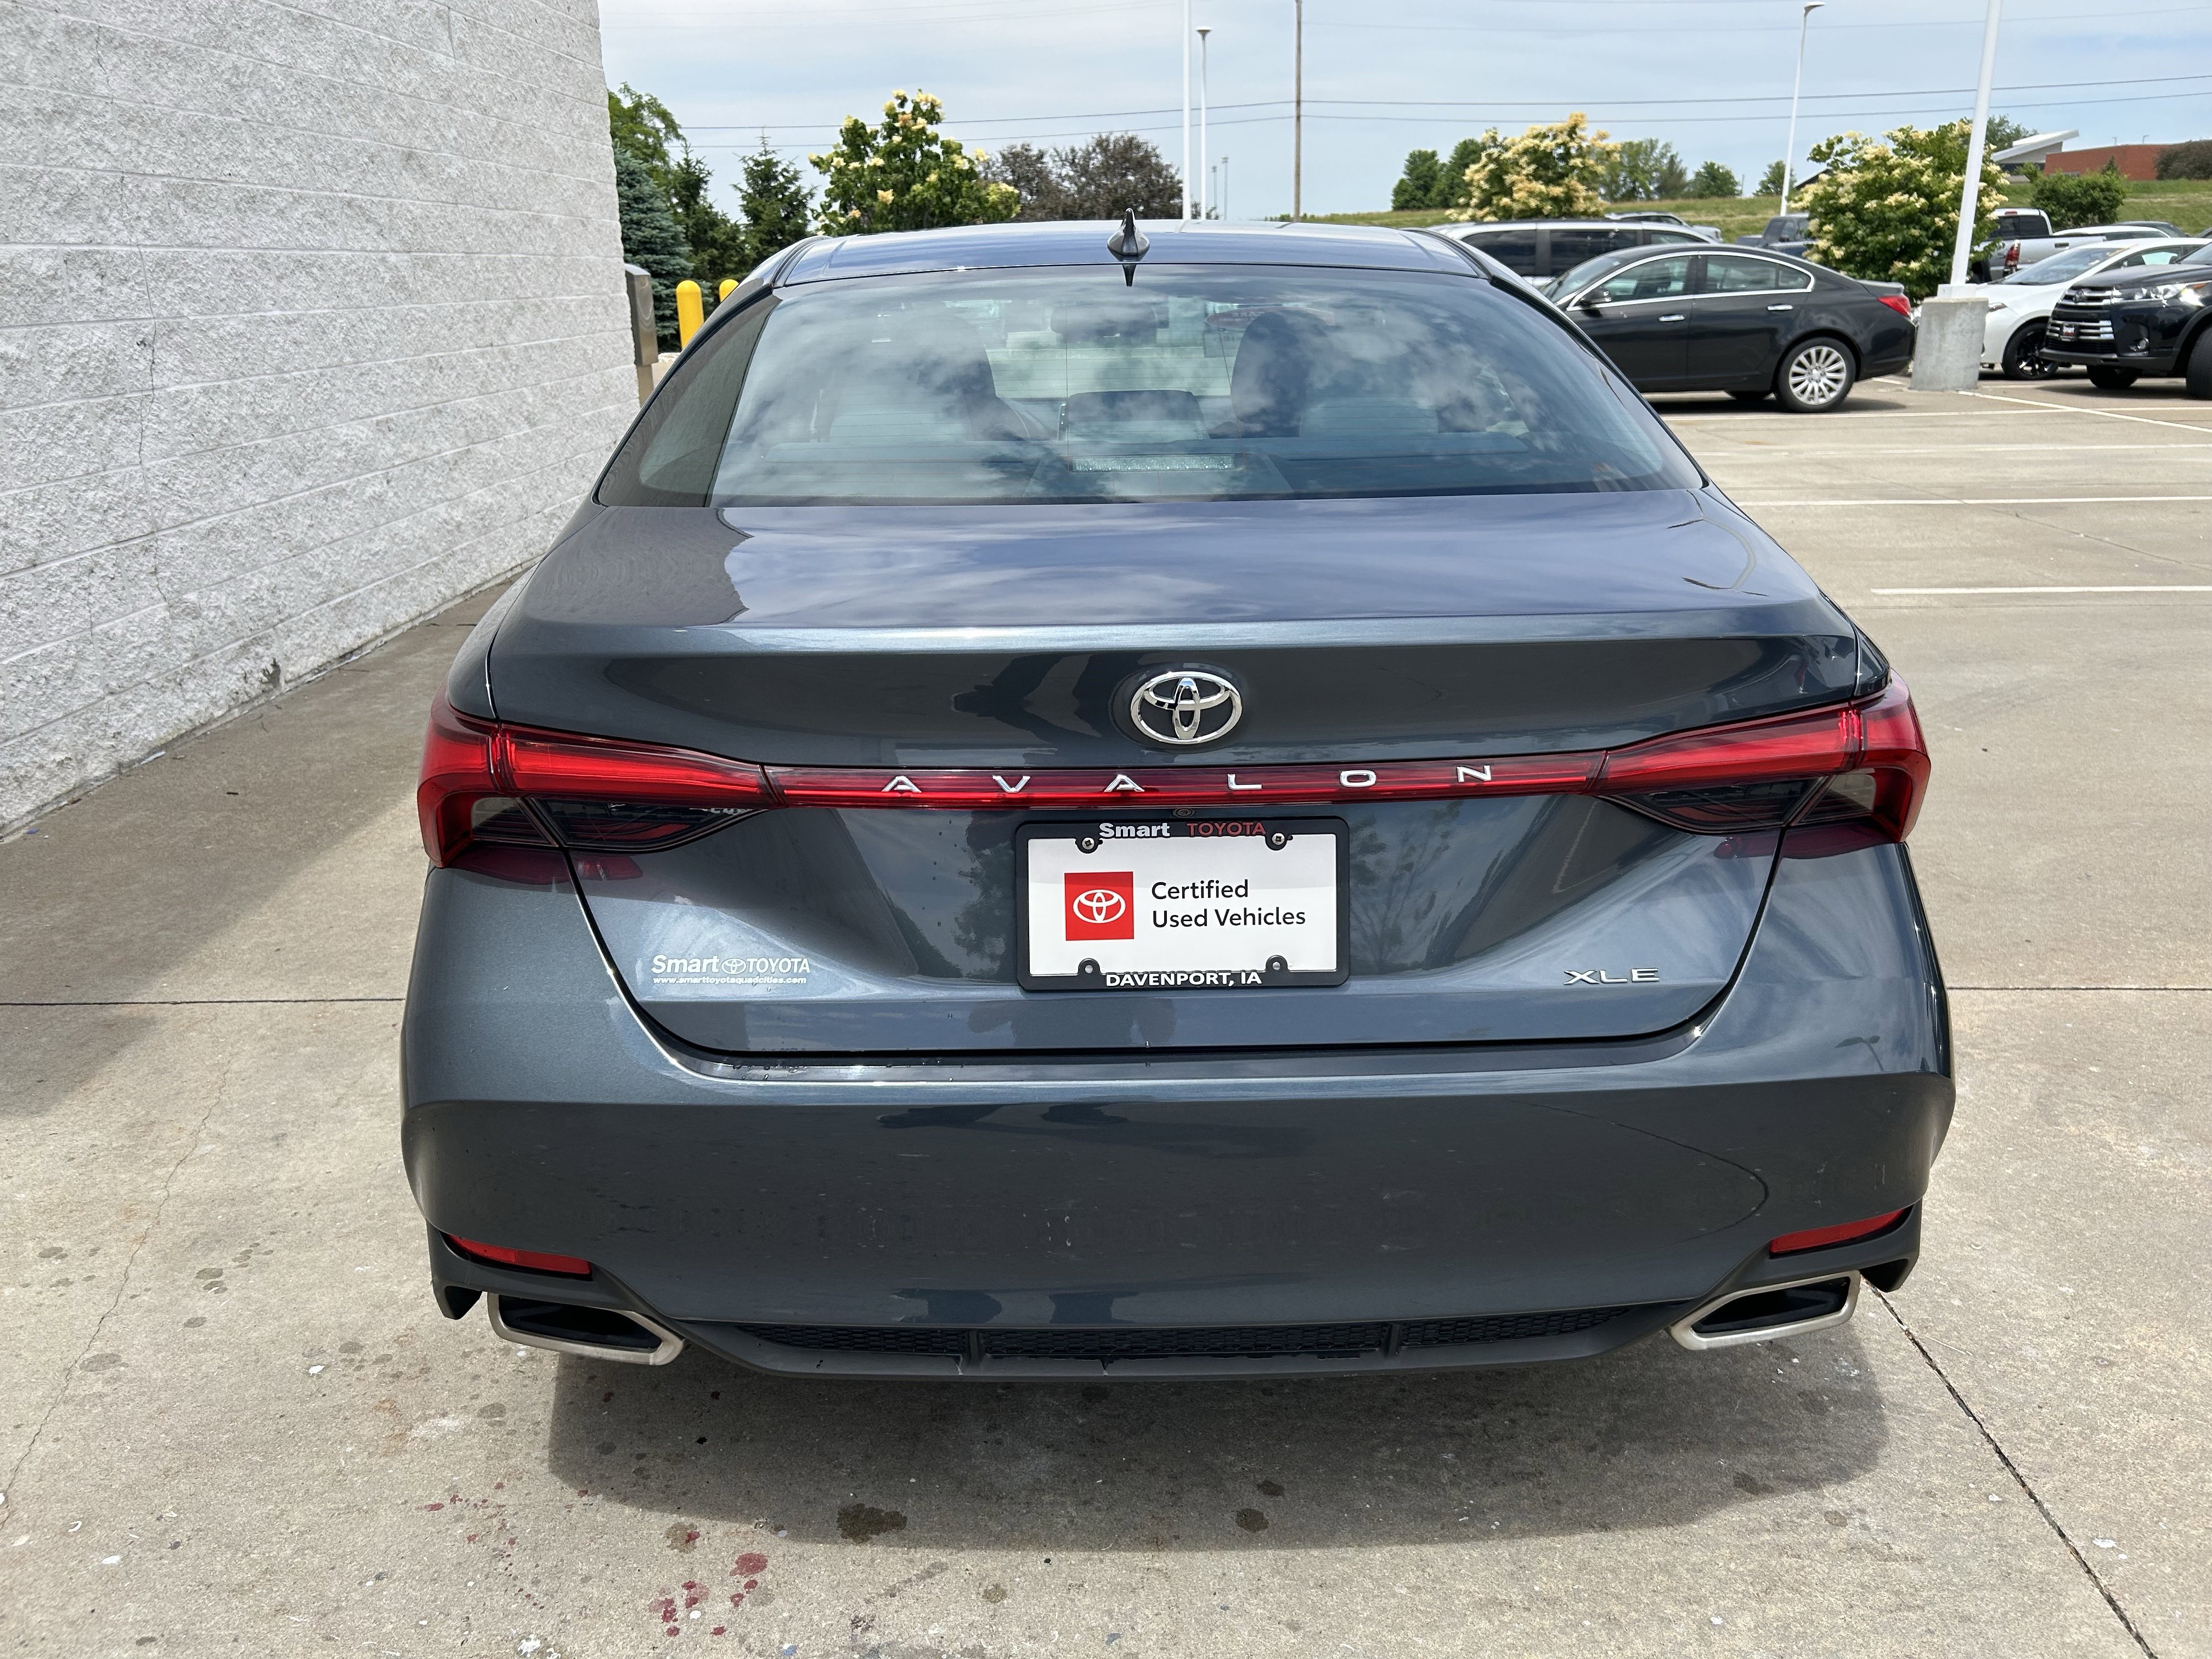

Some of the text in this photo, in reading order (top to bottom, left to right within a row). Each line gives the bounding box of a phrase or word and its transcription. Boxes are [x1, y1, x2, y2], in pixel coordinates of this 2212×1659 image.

[882, 765, 1492, 794] AVALON
[1098, 821, 1267, 839] Smart TOYOTA
[1152, 879, 1249, 900] Certified
[1153, 907, 1306, 928] Used Vehicles
[651, 954, 811, 974] Smart TOYOTA
[653, 976, 807, 985] www.smarttoyotaquadcities.com
[1105, 970, 1262, 988] DAVENPORT, IA
[1564, 967, 1660, 985] XLE
